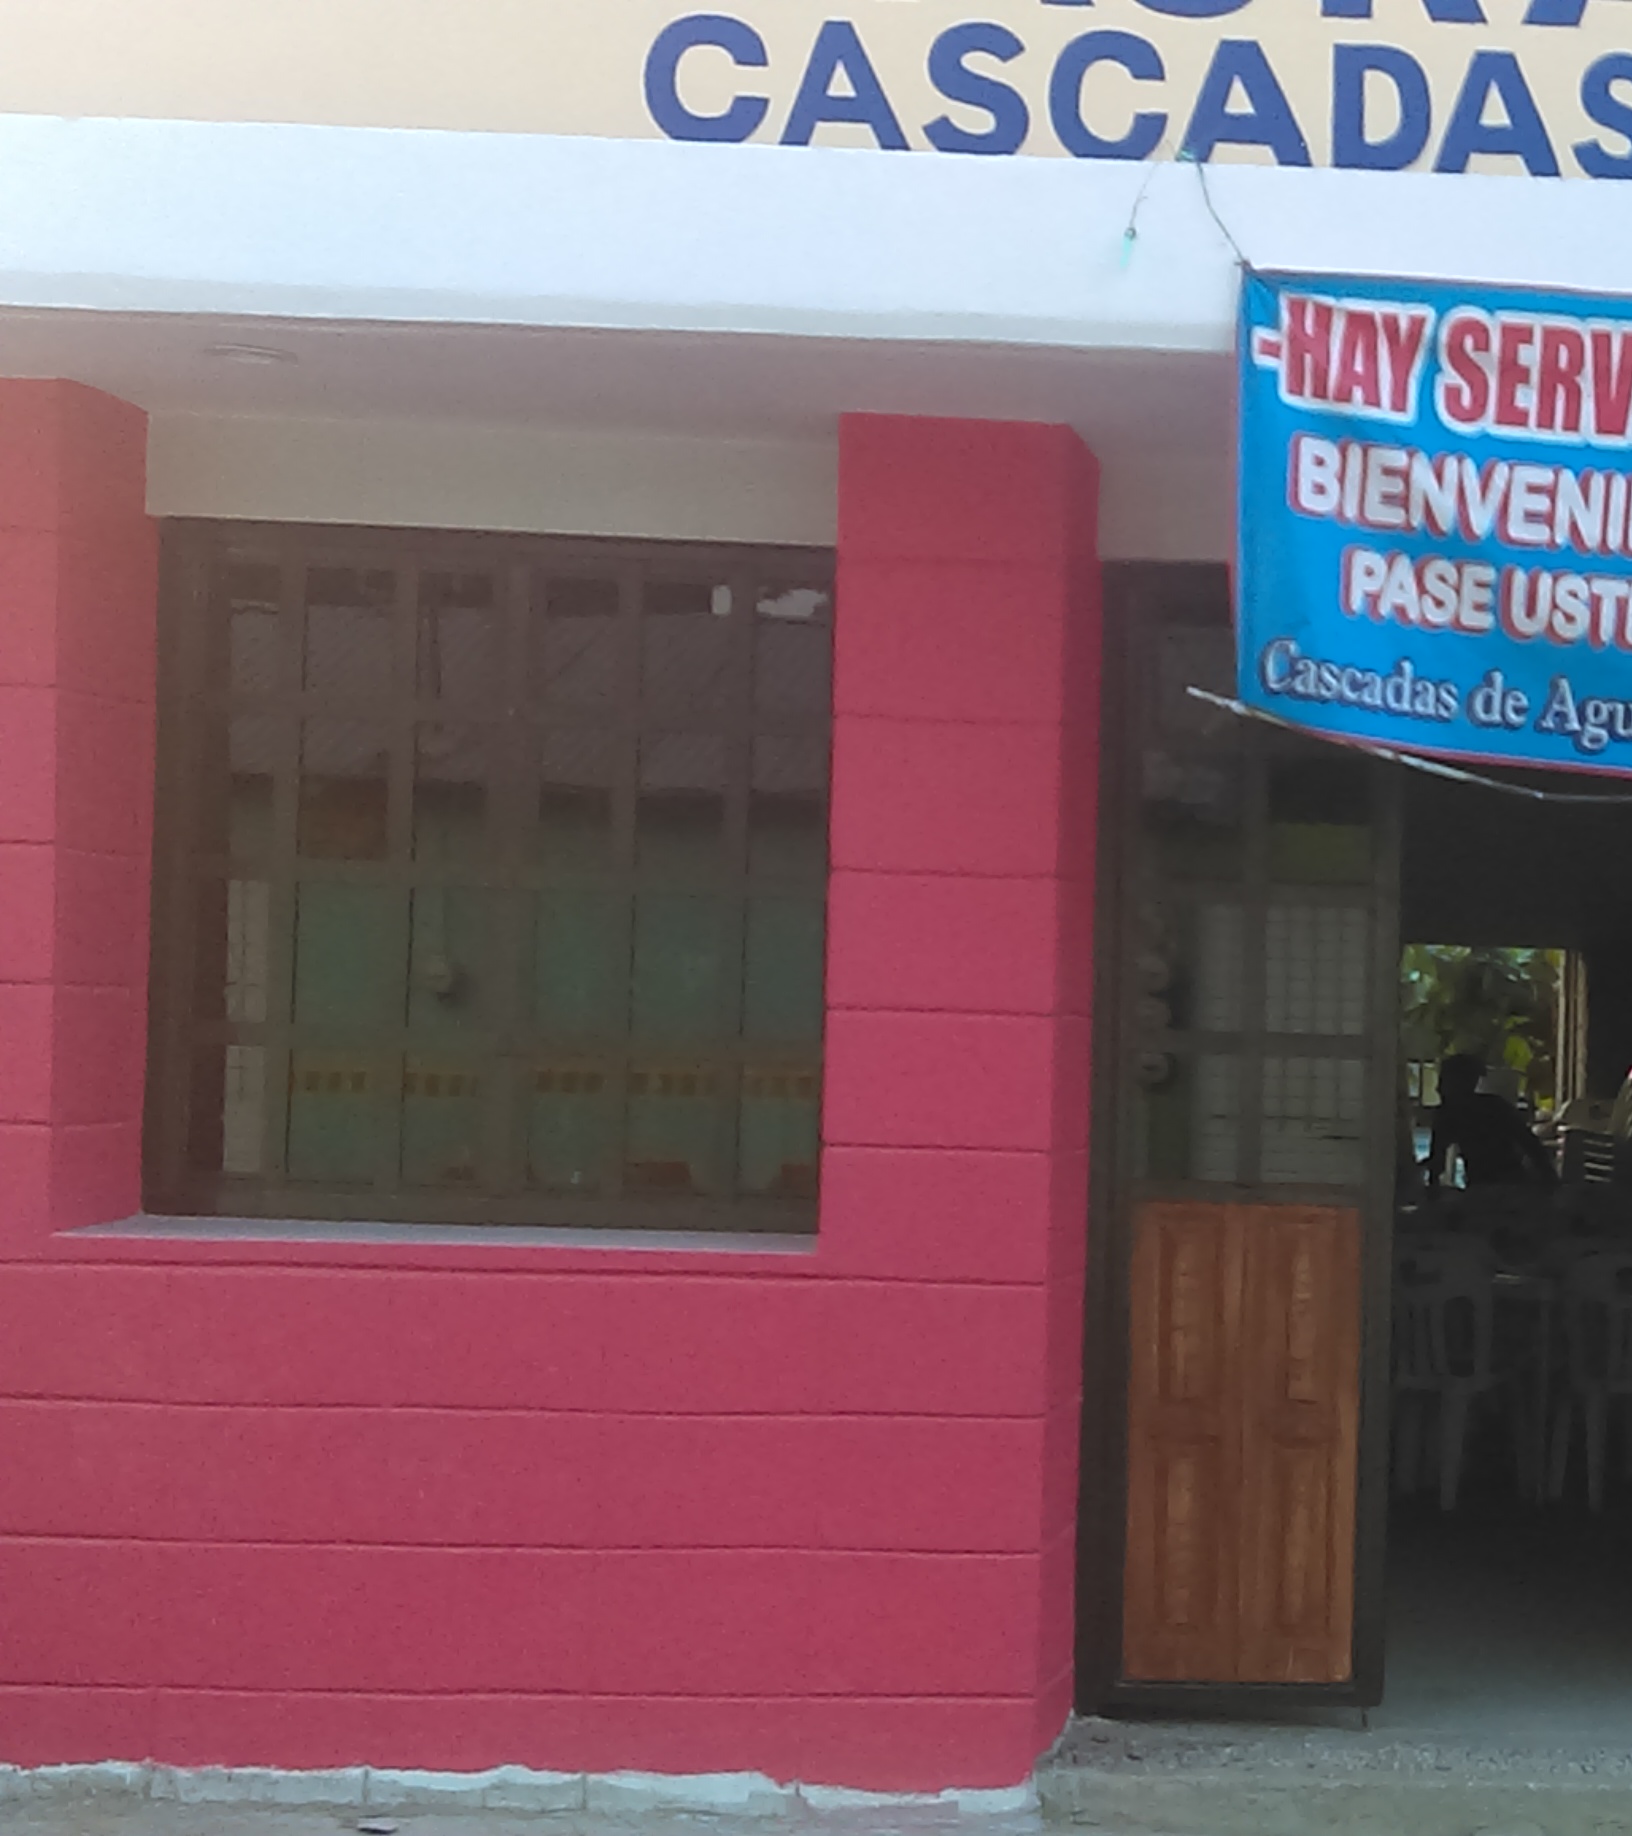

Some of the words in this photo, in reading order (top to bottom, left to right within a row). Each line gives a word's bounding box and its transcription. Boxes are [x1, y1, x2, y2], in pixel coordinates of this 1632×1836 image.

[1341, 547, 1498, 634] PASE
[1259, 637, 1459, 722] Cascadas
[1468, 671, 1530, 727] de
